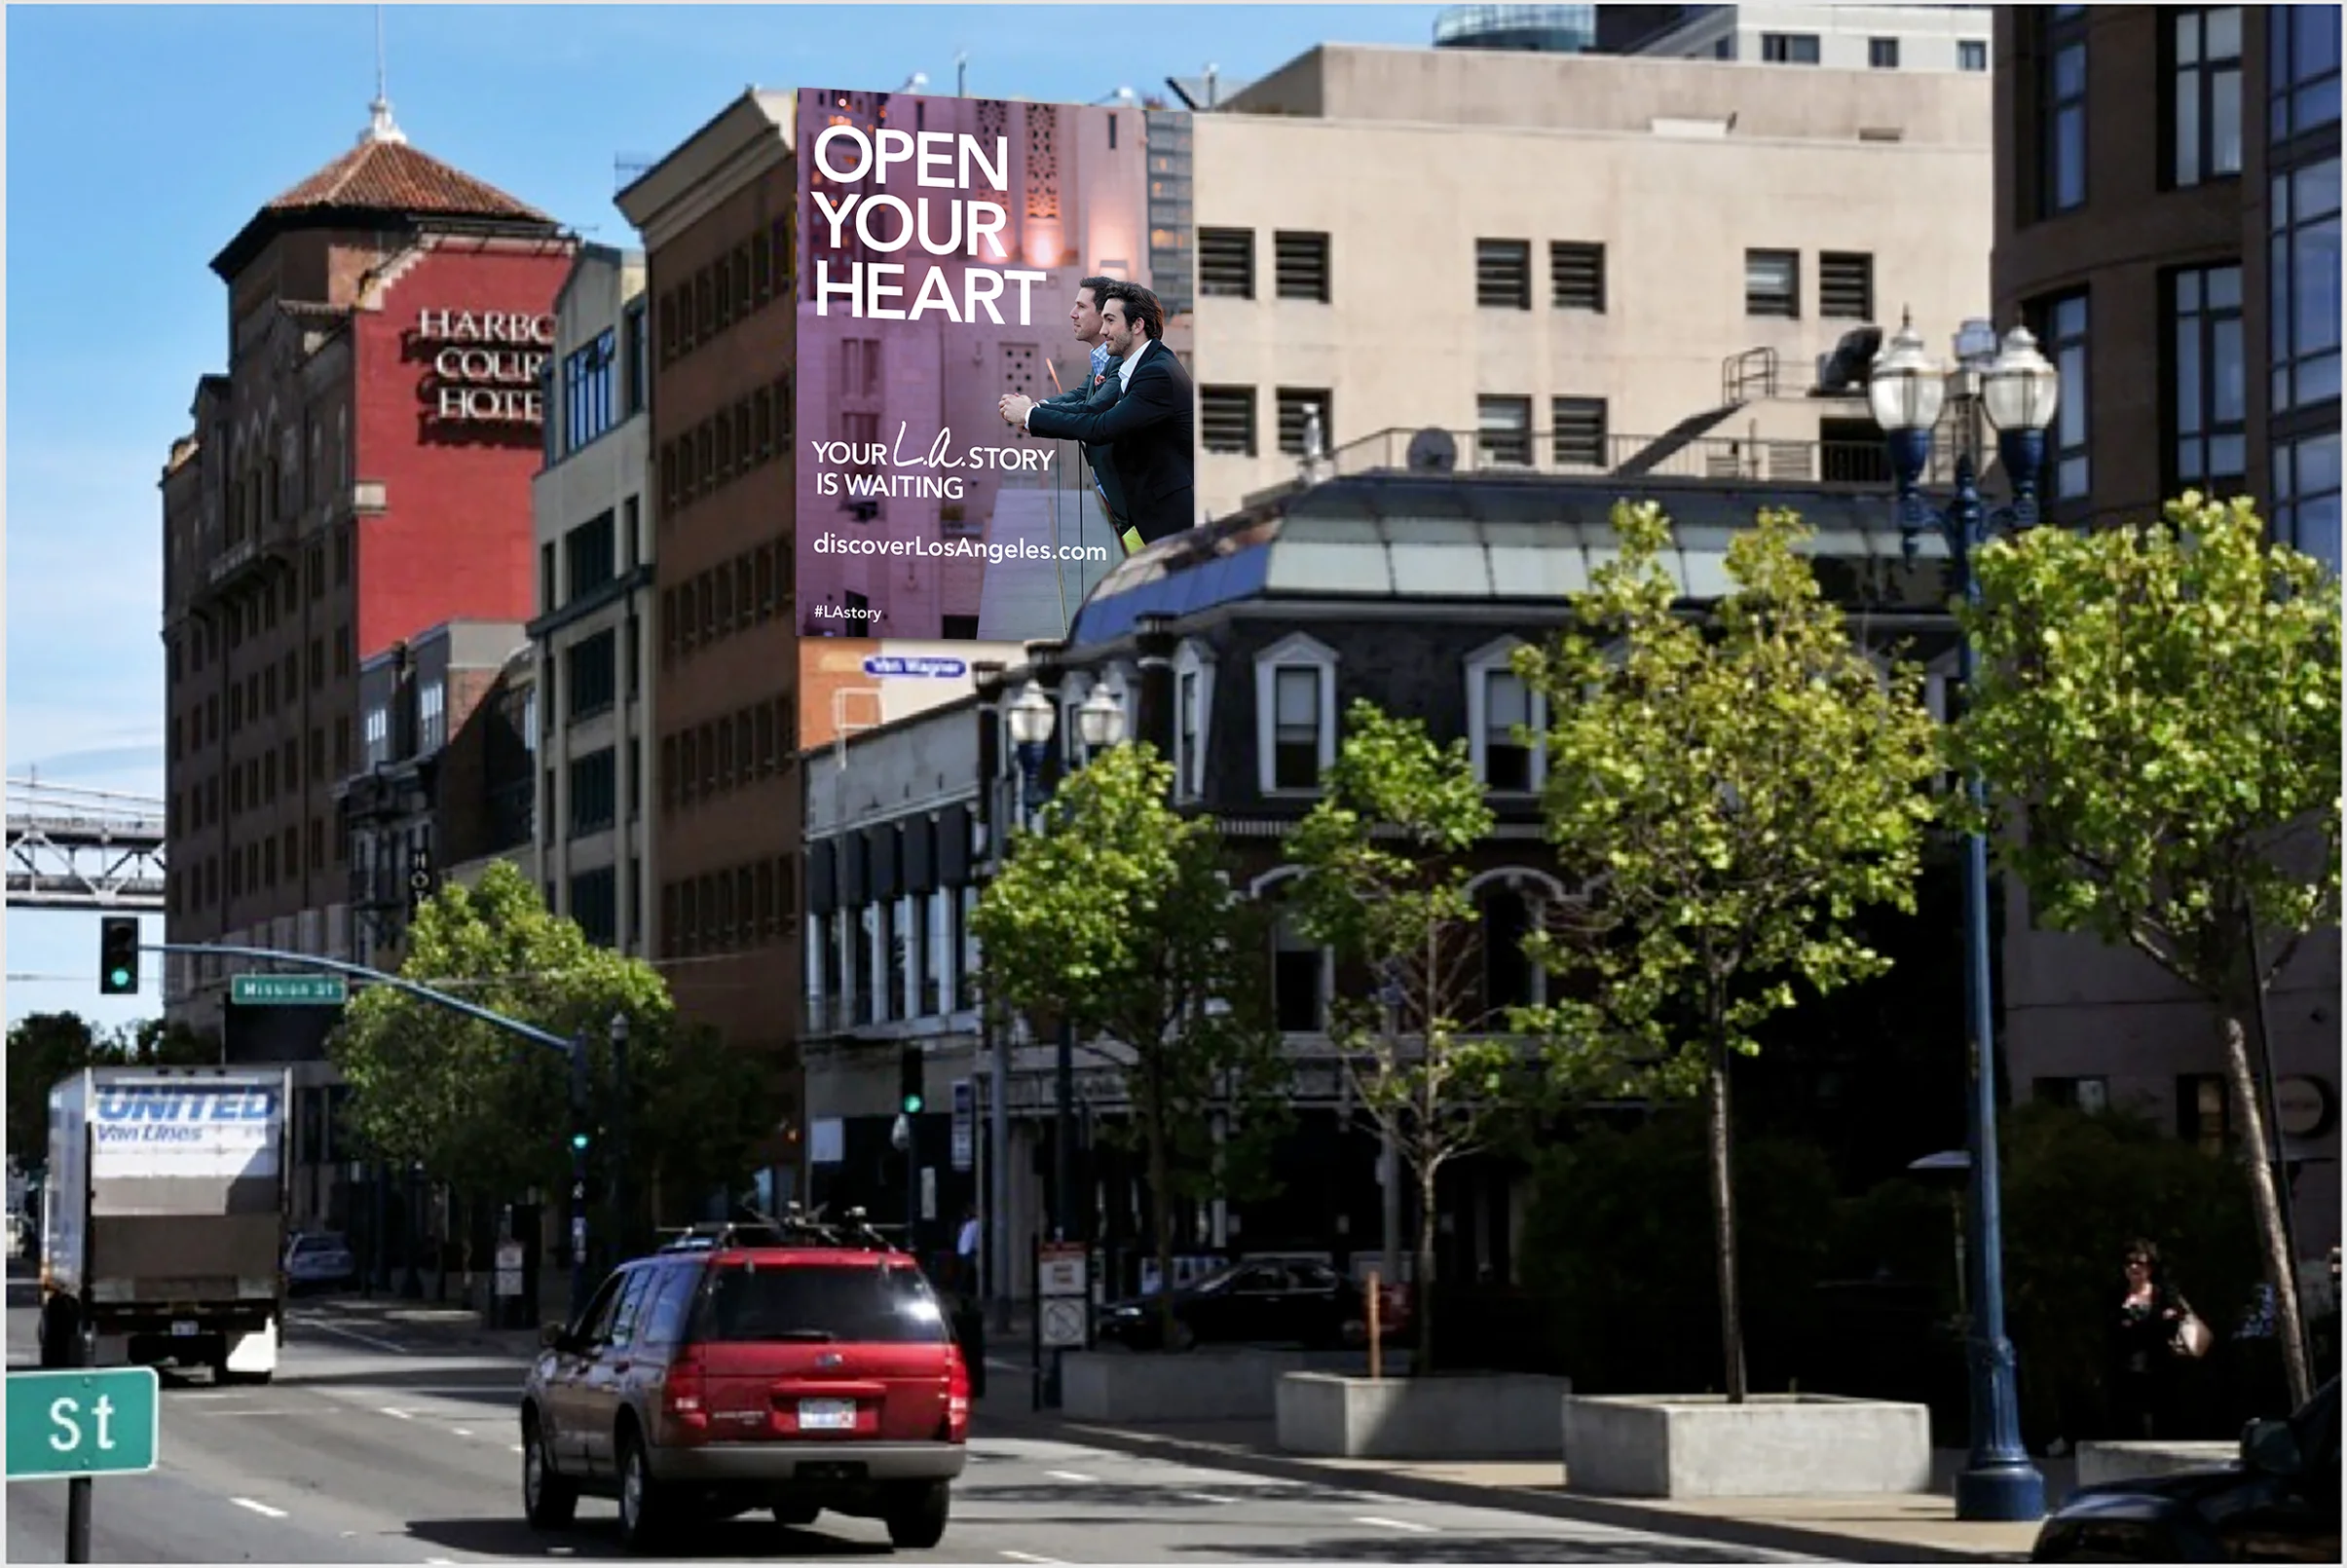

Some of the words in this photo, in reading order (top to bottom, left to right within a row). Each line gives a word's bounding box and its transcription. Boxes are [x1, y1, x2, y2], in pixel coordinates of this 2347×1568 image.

[814, 125, 1008, 191] OPEN
[810, 191, 1008, 257] YOUR
[816, 259, 1047, 326] HEART
[811, 440, 887, 467] YOUR
[968, 446, 1056, 471] STORY
[816, 472, 838, 496] IS
[845, 473, 964, 500] WAITING
[813, 533, 1107, 564] discoverLosAngeles.com
[814, 605, 882, 623] #LAstory
[243, 982, 310, 995] Mission
[316, 982, 333, 996] St
[96, 1085, 278, 1121] UNITED
[97, 1124, 139, 1141] Van
[141, 1124, 204, 1142] Lines
[49, 1394, 117, 1451] St
